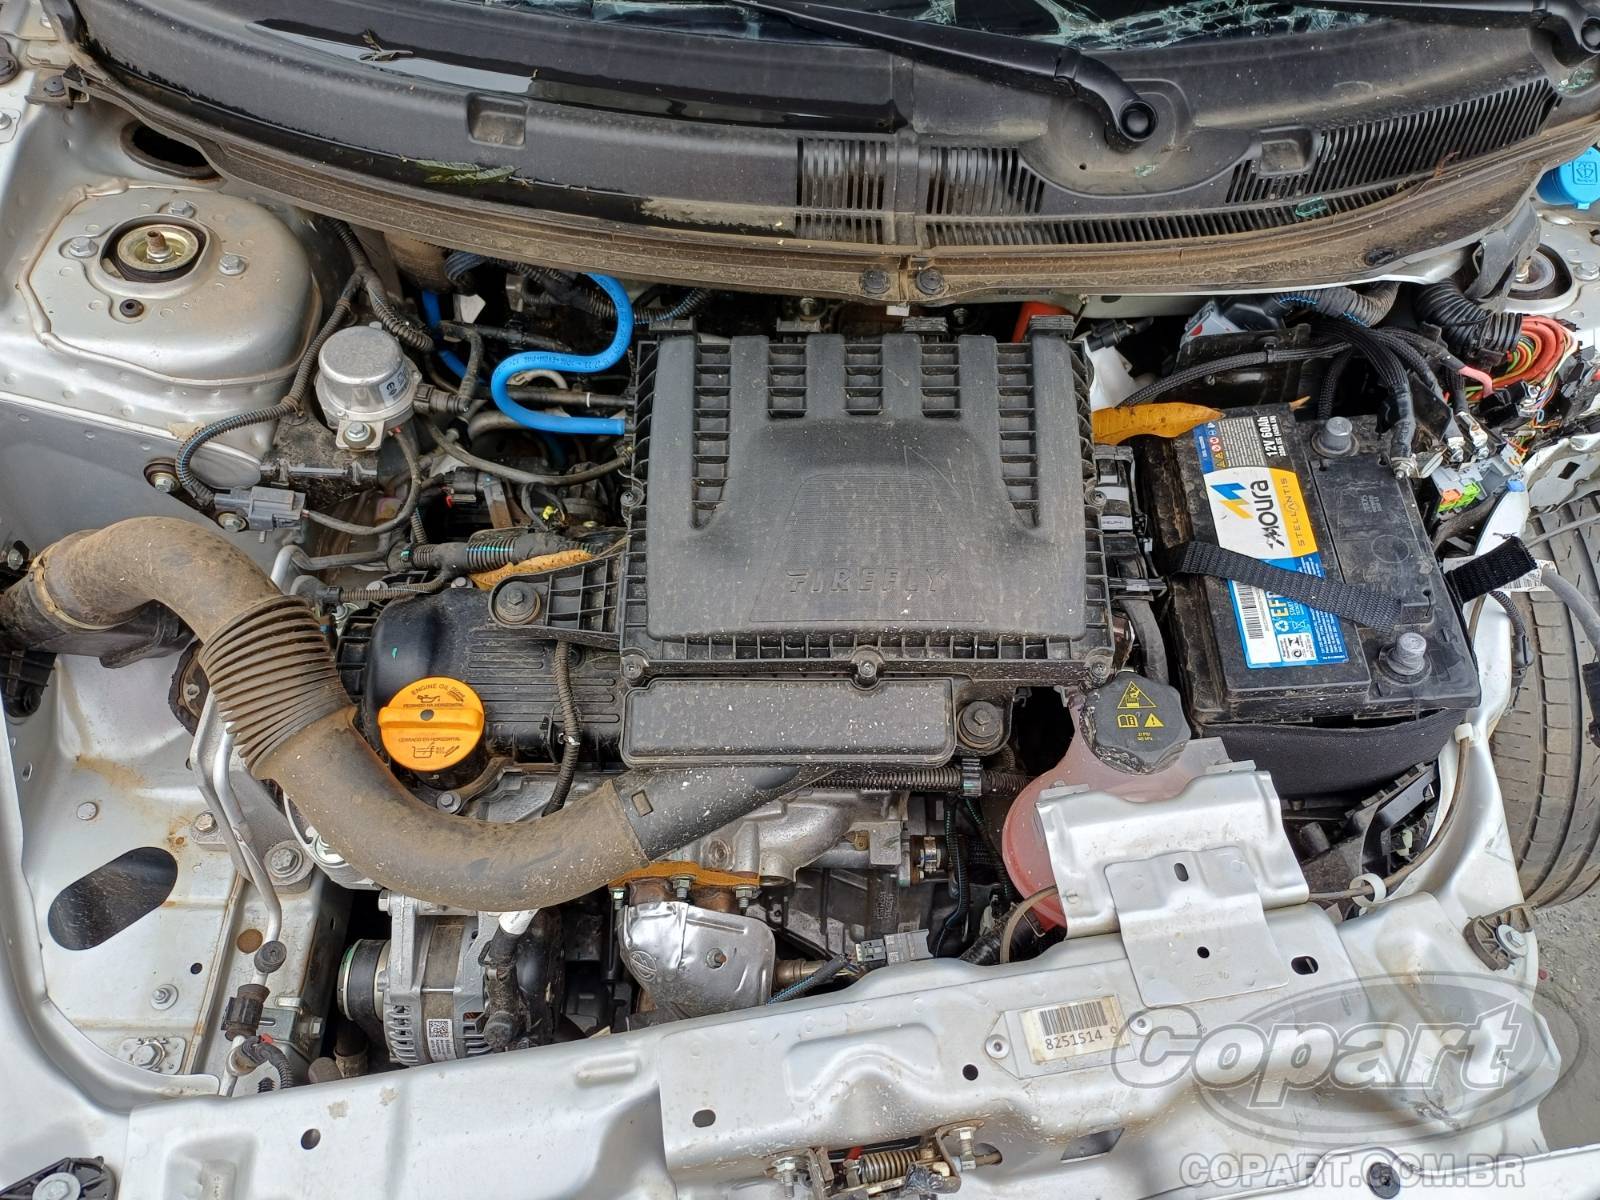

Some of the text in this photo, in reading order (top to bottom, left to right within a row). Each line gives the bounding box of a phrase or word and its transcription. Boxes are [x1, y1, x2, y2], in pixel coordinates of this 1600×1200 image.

[1257, 416, 1278, 457] 12V 60Ah
[1280, 478, 1305, 546] STELLANTIS
[786, 567, 947, 593] FIREFLY
[411, 683, 437, 696] ENGINE
[1045, 1028, 1103, 1050] 8251514
